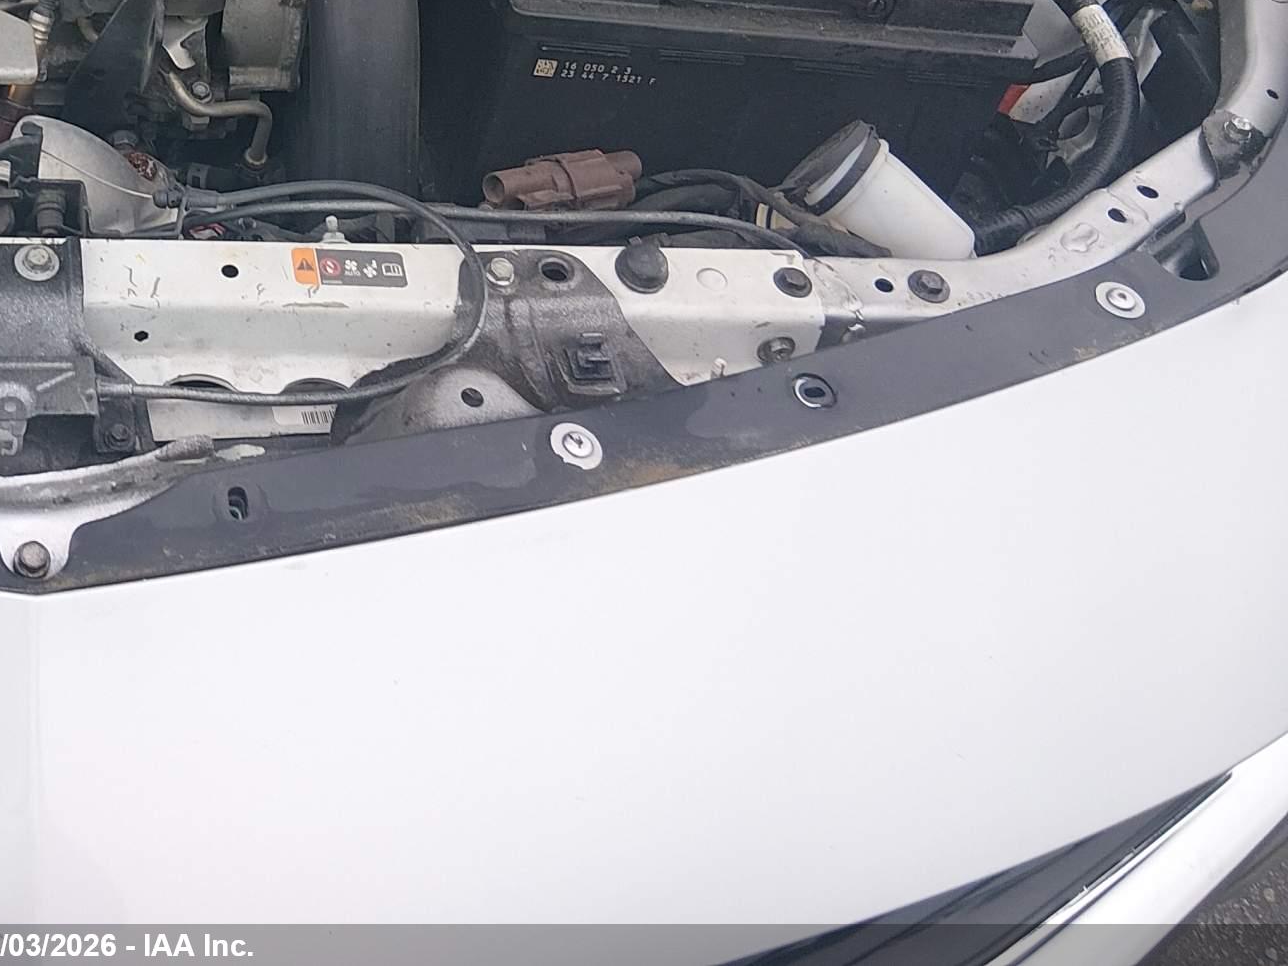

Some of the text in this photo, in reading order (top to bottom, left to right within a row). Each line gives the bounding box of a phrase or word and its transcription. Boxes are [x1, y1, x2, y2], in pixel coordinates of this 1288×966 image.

[564, 61, 577, 70] 16
[611, 66, 619, 74] 2
[624, 66, 632, 75] 3
[561, 69, 575, 78] 23
[581, 71, 595, 80] 44
[602, 73, 609, 81] 7
